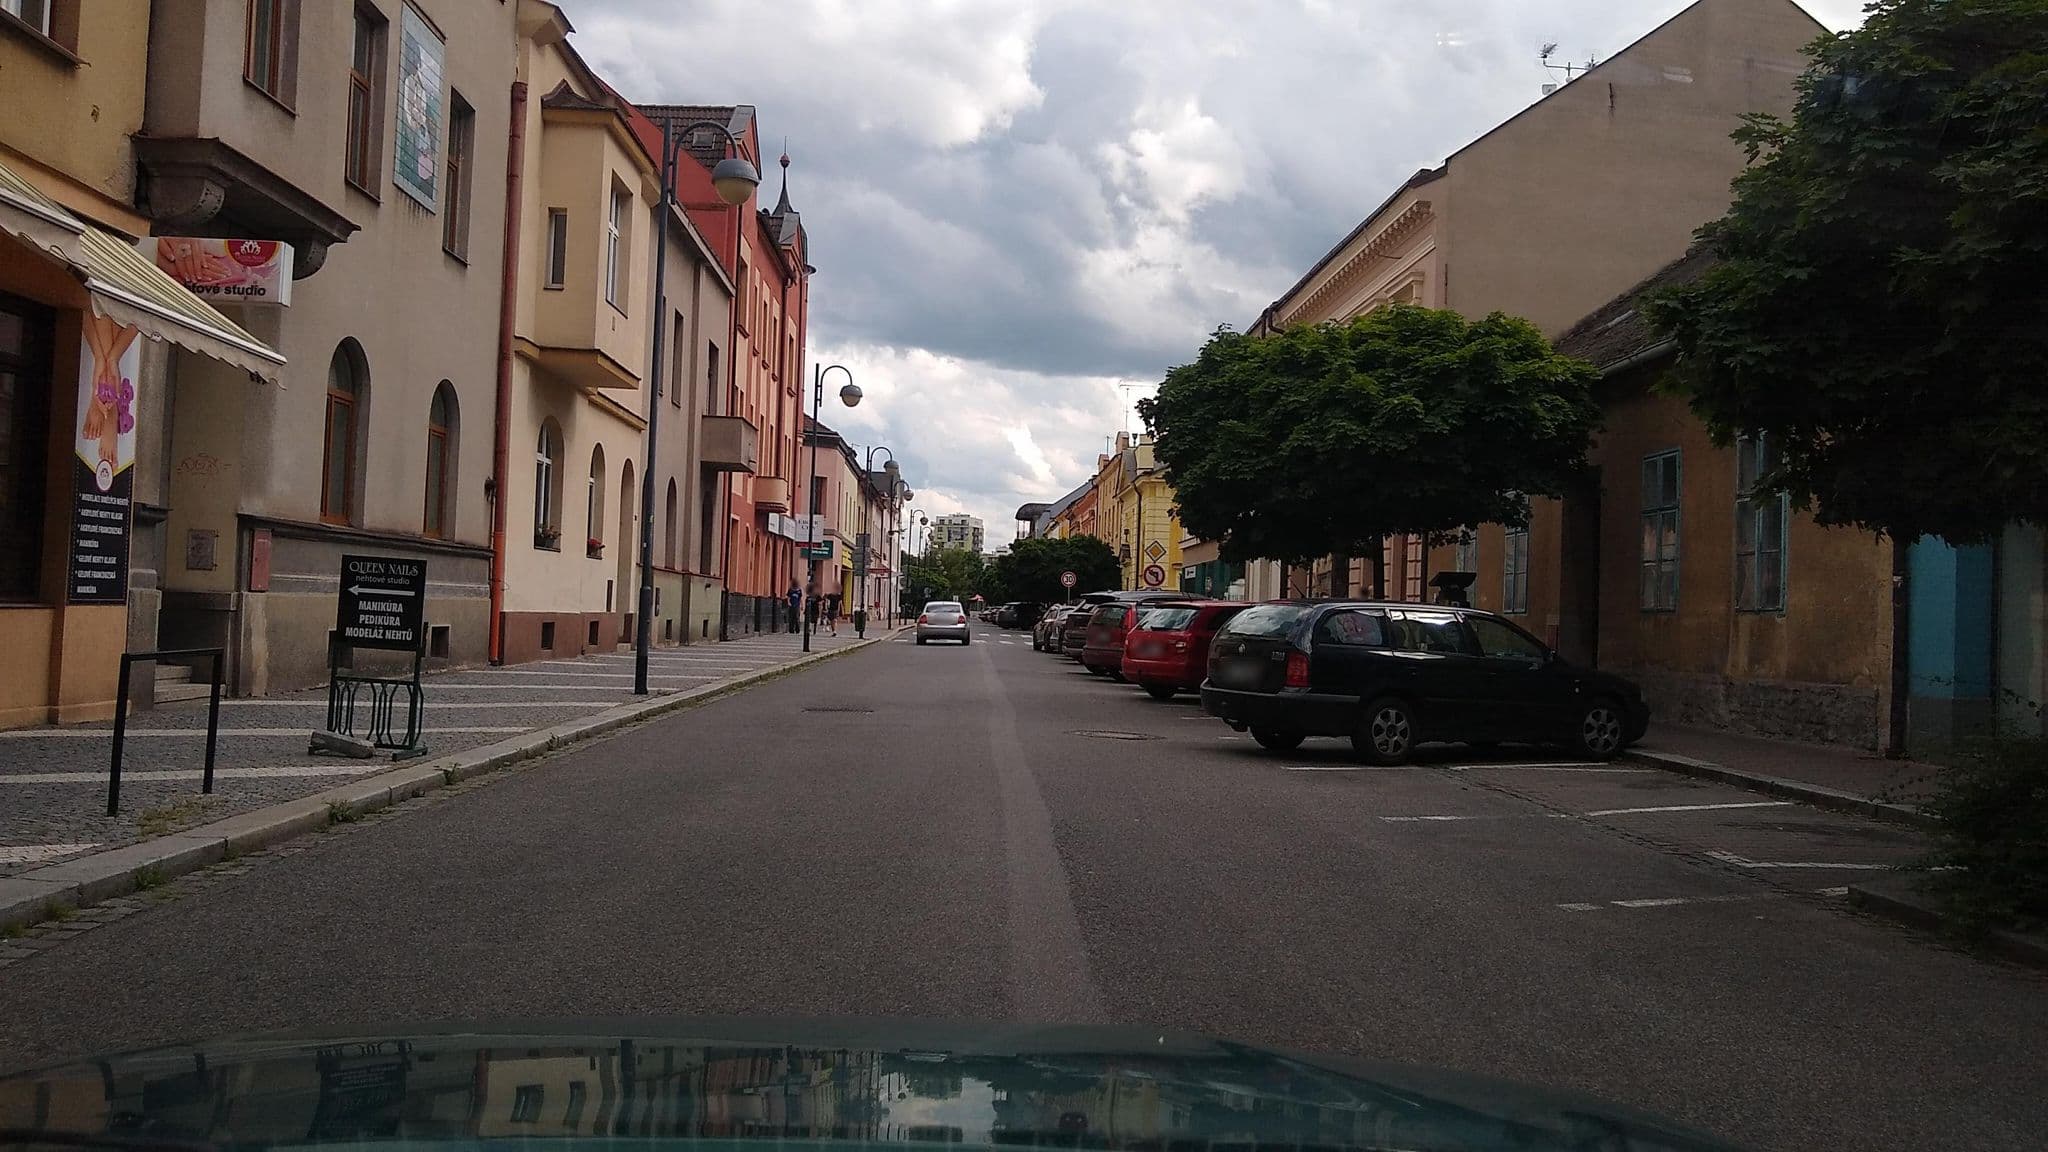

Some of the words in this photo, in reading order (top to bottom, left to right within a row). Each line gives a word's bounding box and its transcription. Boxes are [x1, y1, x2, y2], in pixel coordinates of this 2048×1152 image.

[223, 282, 267, 296] studio
[349, 561, 385, 574] QUEEN
[389, 564, 418, 576] NAILS
[356, 575, 385, 583] nehtové
[387, 577, 410, 585] studio
[1064, 575, 1073, 583] 30
[358, 600, 403, 613] MANIKÚRA
[359, 613, 400, 626] PEDIKÚRA
[345, 626, 383, 639] MODELÁŽ
[385, 628, 413, 640] NEHTŮ
